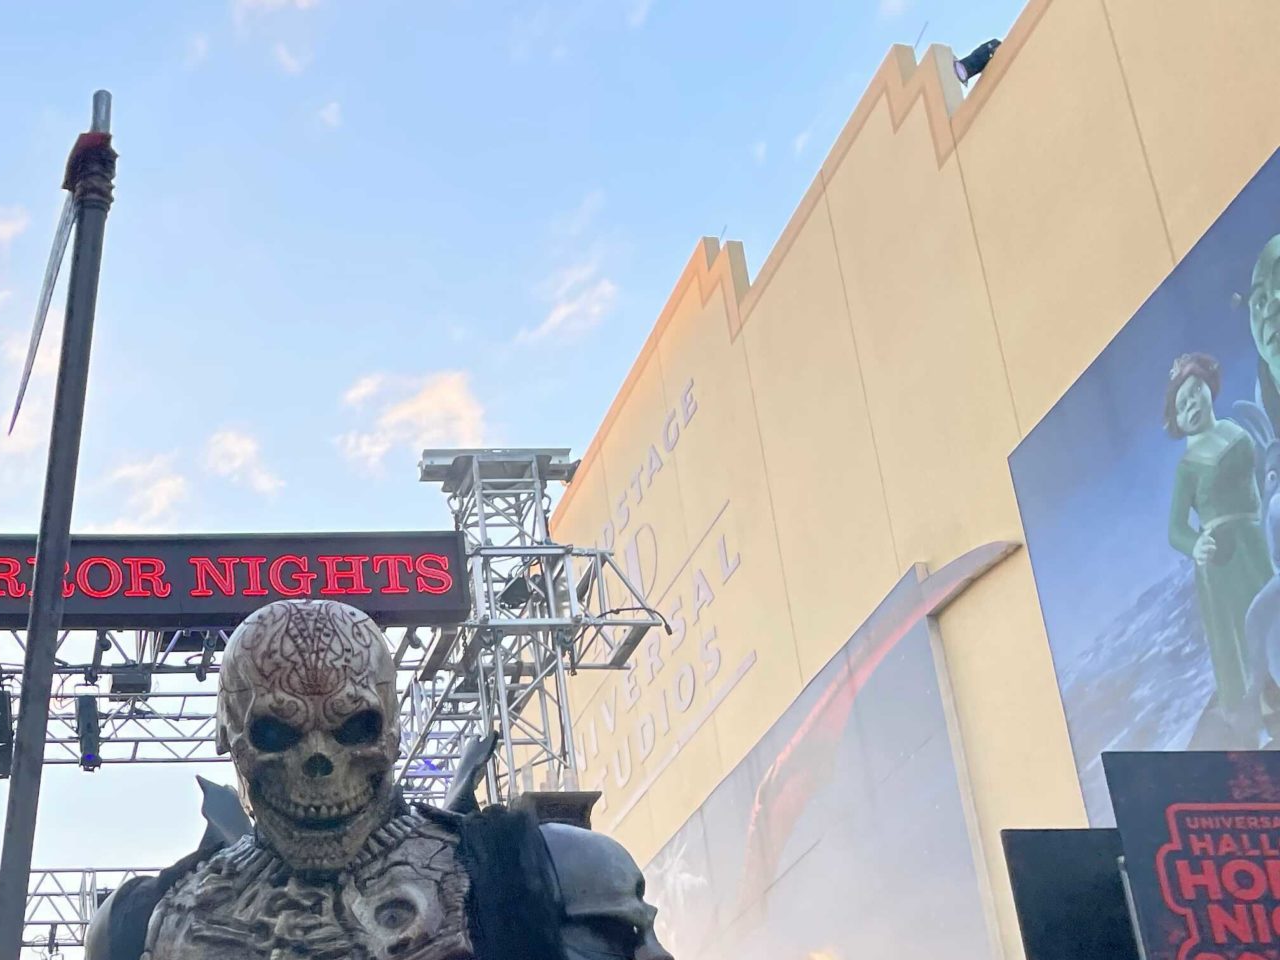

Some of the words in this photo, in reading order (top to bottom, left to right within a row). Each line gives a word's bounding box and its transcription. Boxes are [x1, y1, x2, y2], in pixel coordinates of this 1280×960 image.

[189, 554, 454, 597] NIGHTS
[577, 533, 741, 771] NIVERSAL
[593, 625, 721, 815] TUDIOS
[1189, 834, 1280, 856] HALL
[1207, 904, 1280, 943] NI
